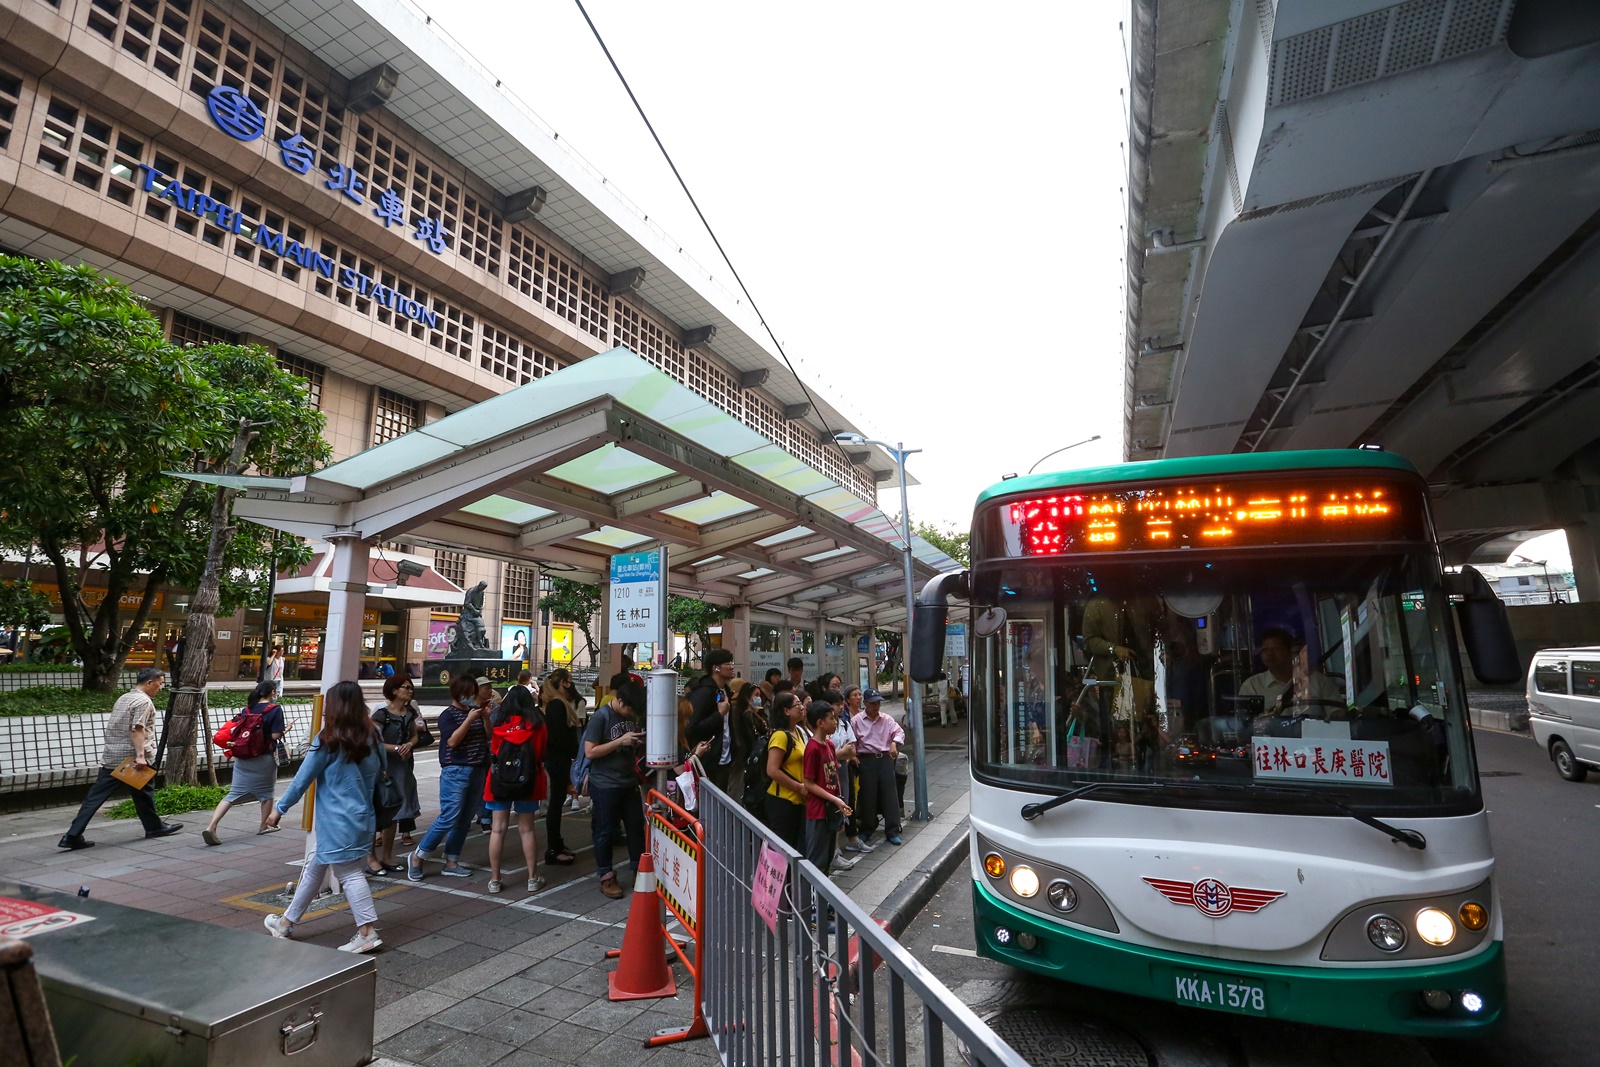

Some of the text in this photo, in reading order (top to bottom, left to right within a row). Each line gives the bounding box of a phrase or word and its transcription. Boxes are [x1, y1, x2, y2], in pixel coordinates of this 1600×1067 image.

[279, 132, 449, 256] 台北車站
[139, 163, 437, 329] TAIPEI MAIN STATION
[614, 587, 630, 599] 1210
[1256, 744, 1388, 779] 往林口長庚醫院
[653, 836, 692, 901] 禁止進入
